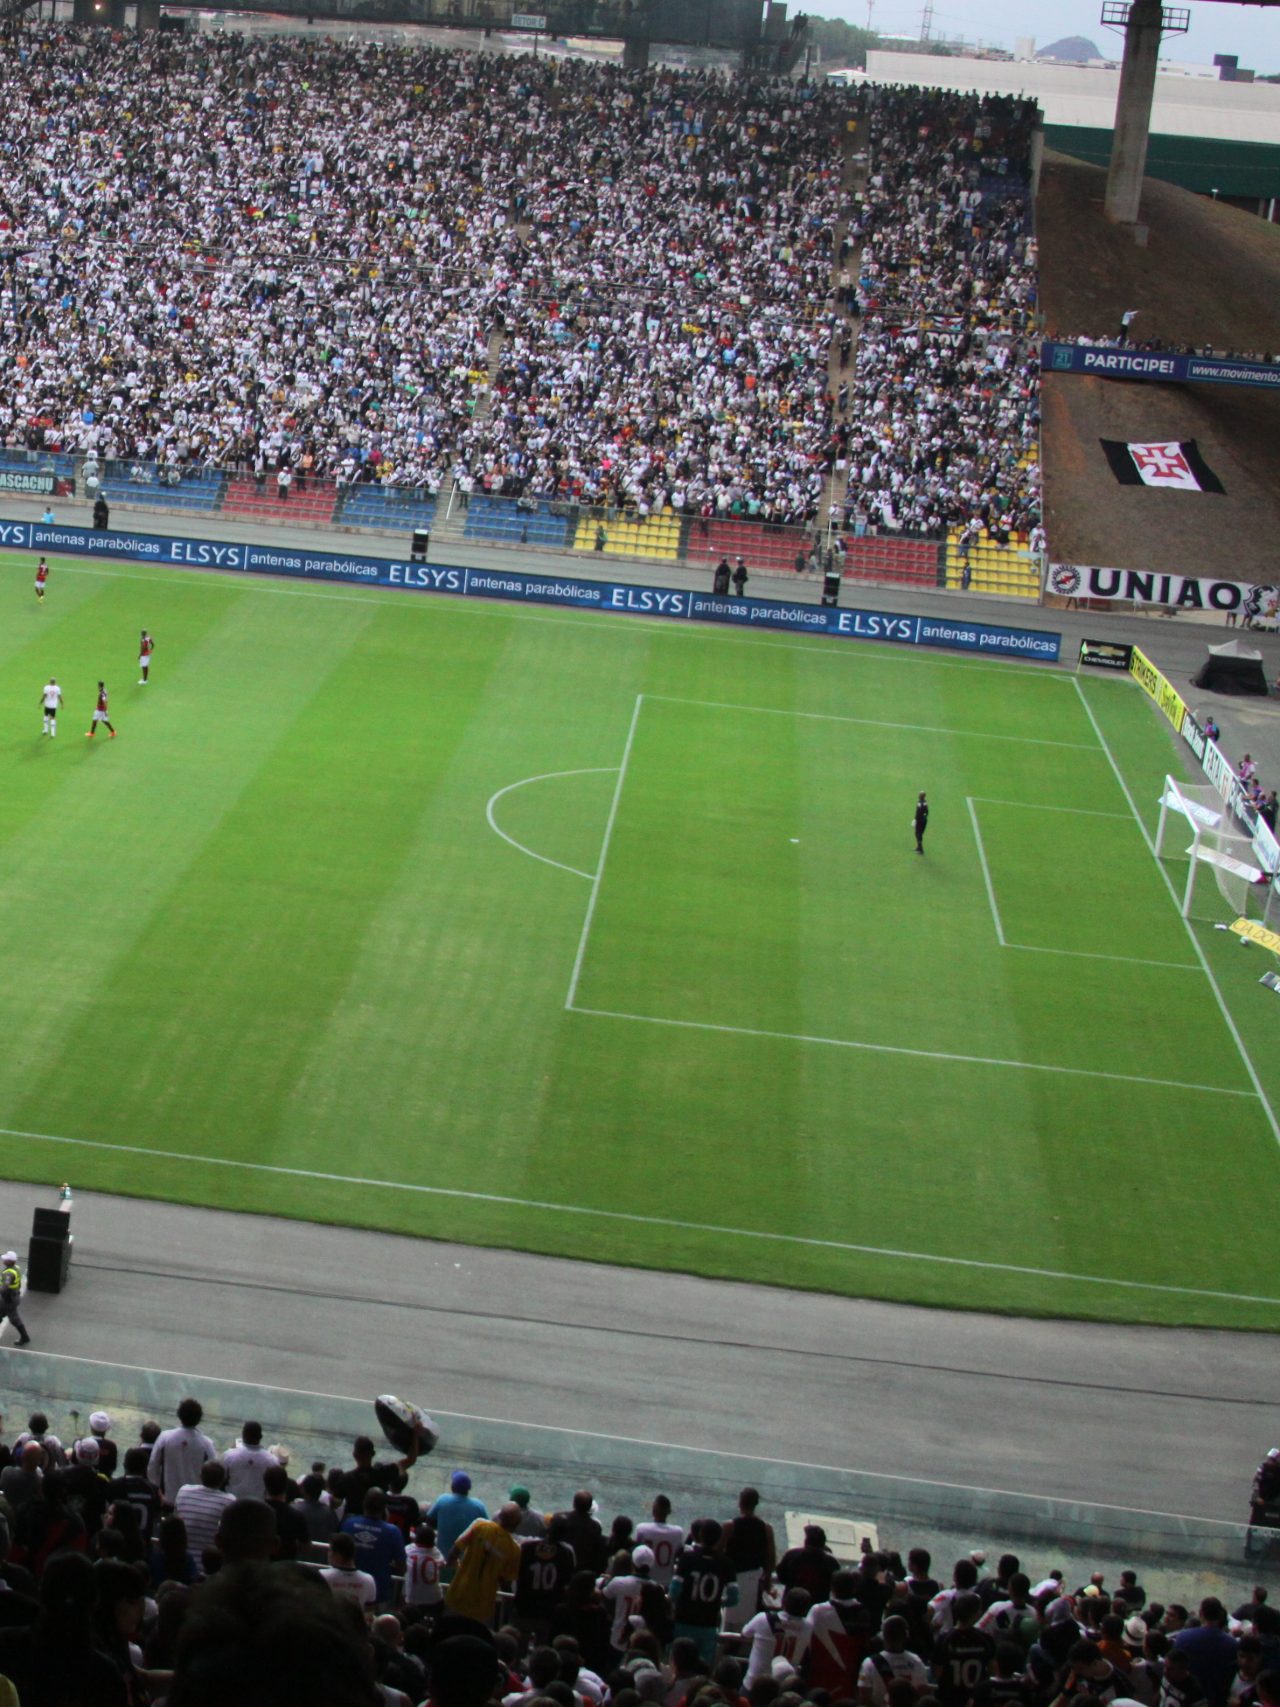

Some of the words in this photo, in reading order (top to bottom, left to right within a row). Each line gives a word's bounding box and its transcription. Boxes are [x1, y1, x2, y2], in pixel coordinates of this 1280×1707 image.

[1084, 353, 1174, 374] PARTICIPE!
[35, 532, 85, 546] antenas
[88, 538, 160, 554] parabólicas
[170, 542, 239, 566] ELSYS
[250, 553, 302, 568] antenas
[304, 559, 379, 576] parabólicas
[389, 565, 459, 589] ELSYS
[470, 577, 522, 592] antenas
[525, 584, 601, 600] parabólicas
[612, 588, 683, 613] ELSYS
[694, 601, 748, 616] antenas
[750, 607, 827, 625] parabólicas
[838, 613, 912, 638] ELSYS
[922, 626, 976, 642] antenas
[979, 633, 1058, 653] parabólicas
[1084, 656, 1126, 667] CHEVROLET
[410, 1555, 439, 1585] 10
[529, 1561, 558, 1590] 10
[690, 1571, 719, 1602] 10
[949, 1658, 982, 1689] 10
